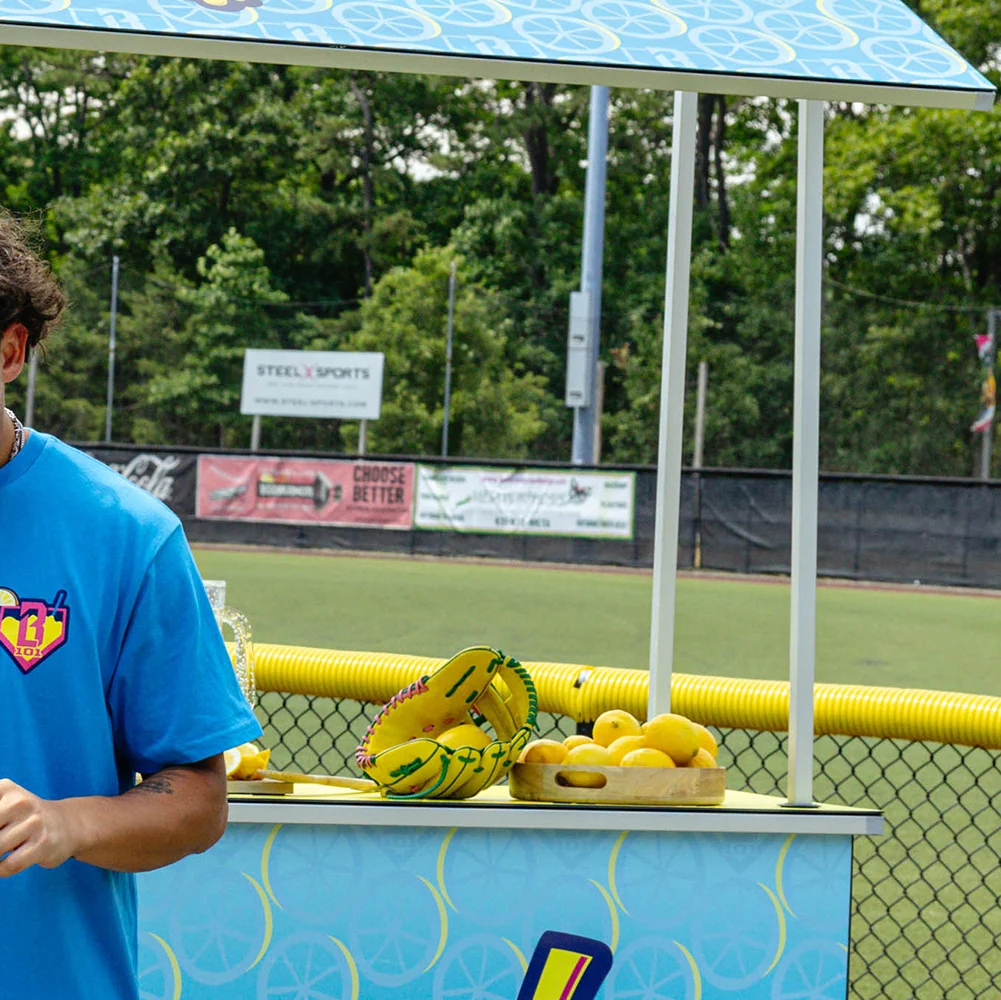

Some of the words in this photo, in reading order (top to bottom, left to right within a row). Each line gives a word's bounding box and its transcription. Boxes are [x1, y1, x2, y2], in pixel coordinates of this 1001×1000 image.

[353, 465, 406, 484] CHOOSE
[353, 485, 404, 504] BETTER
[14, 647, 42, 657] 101
